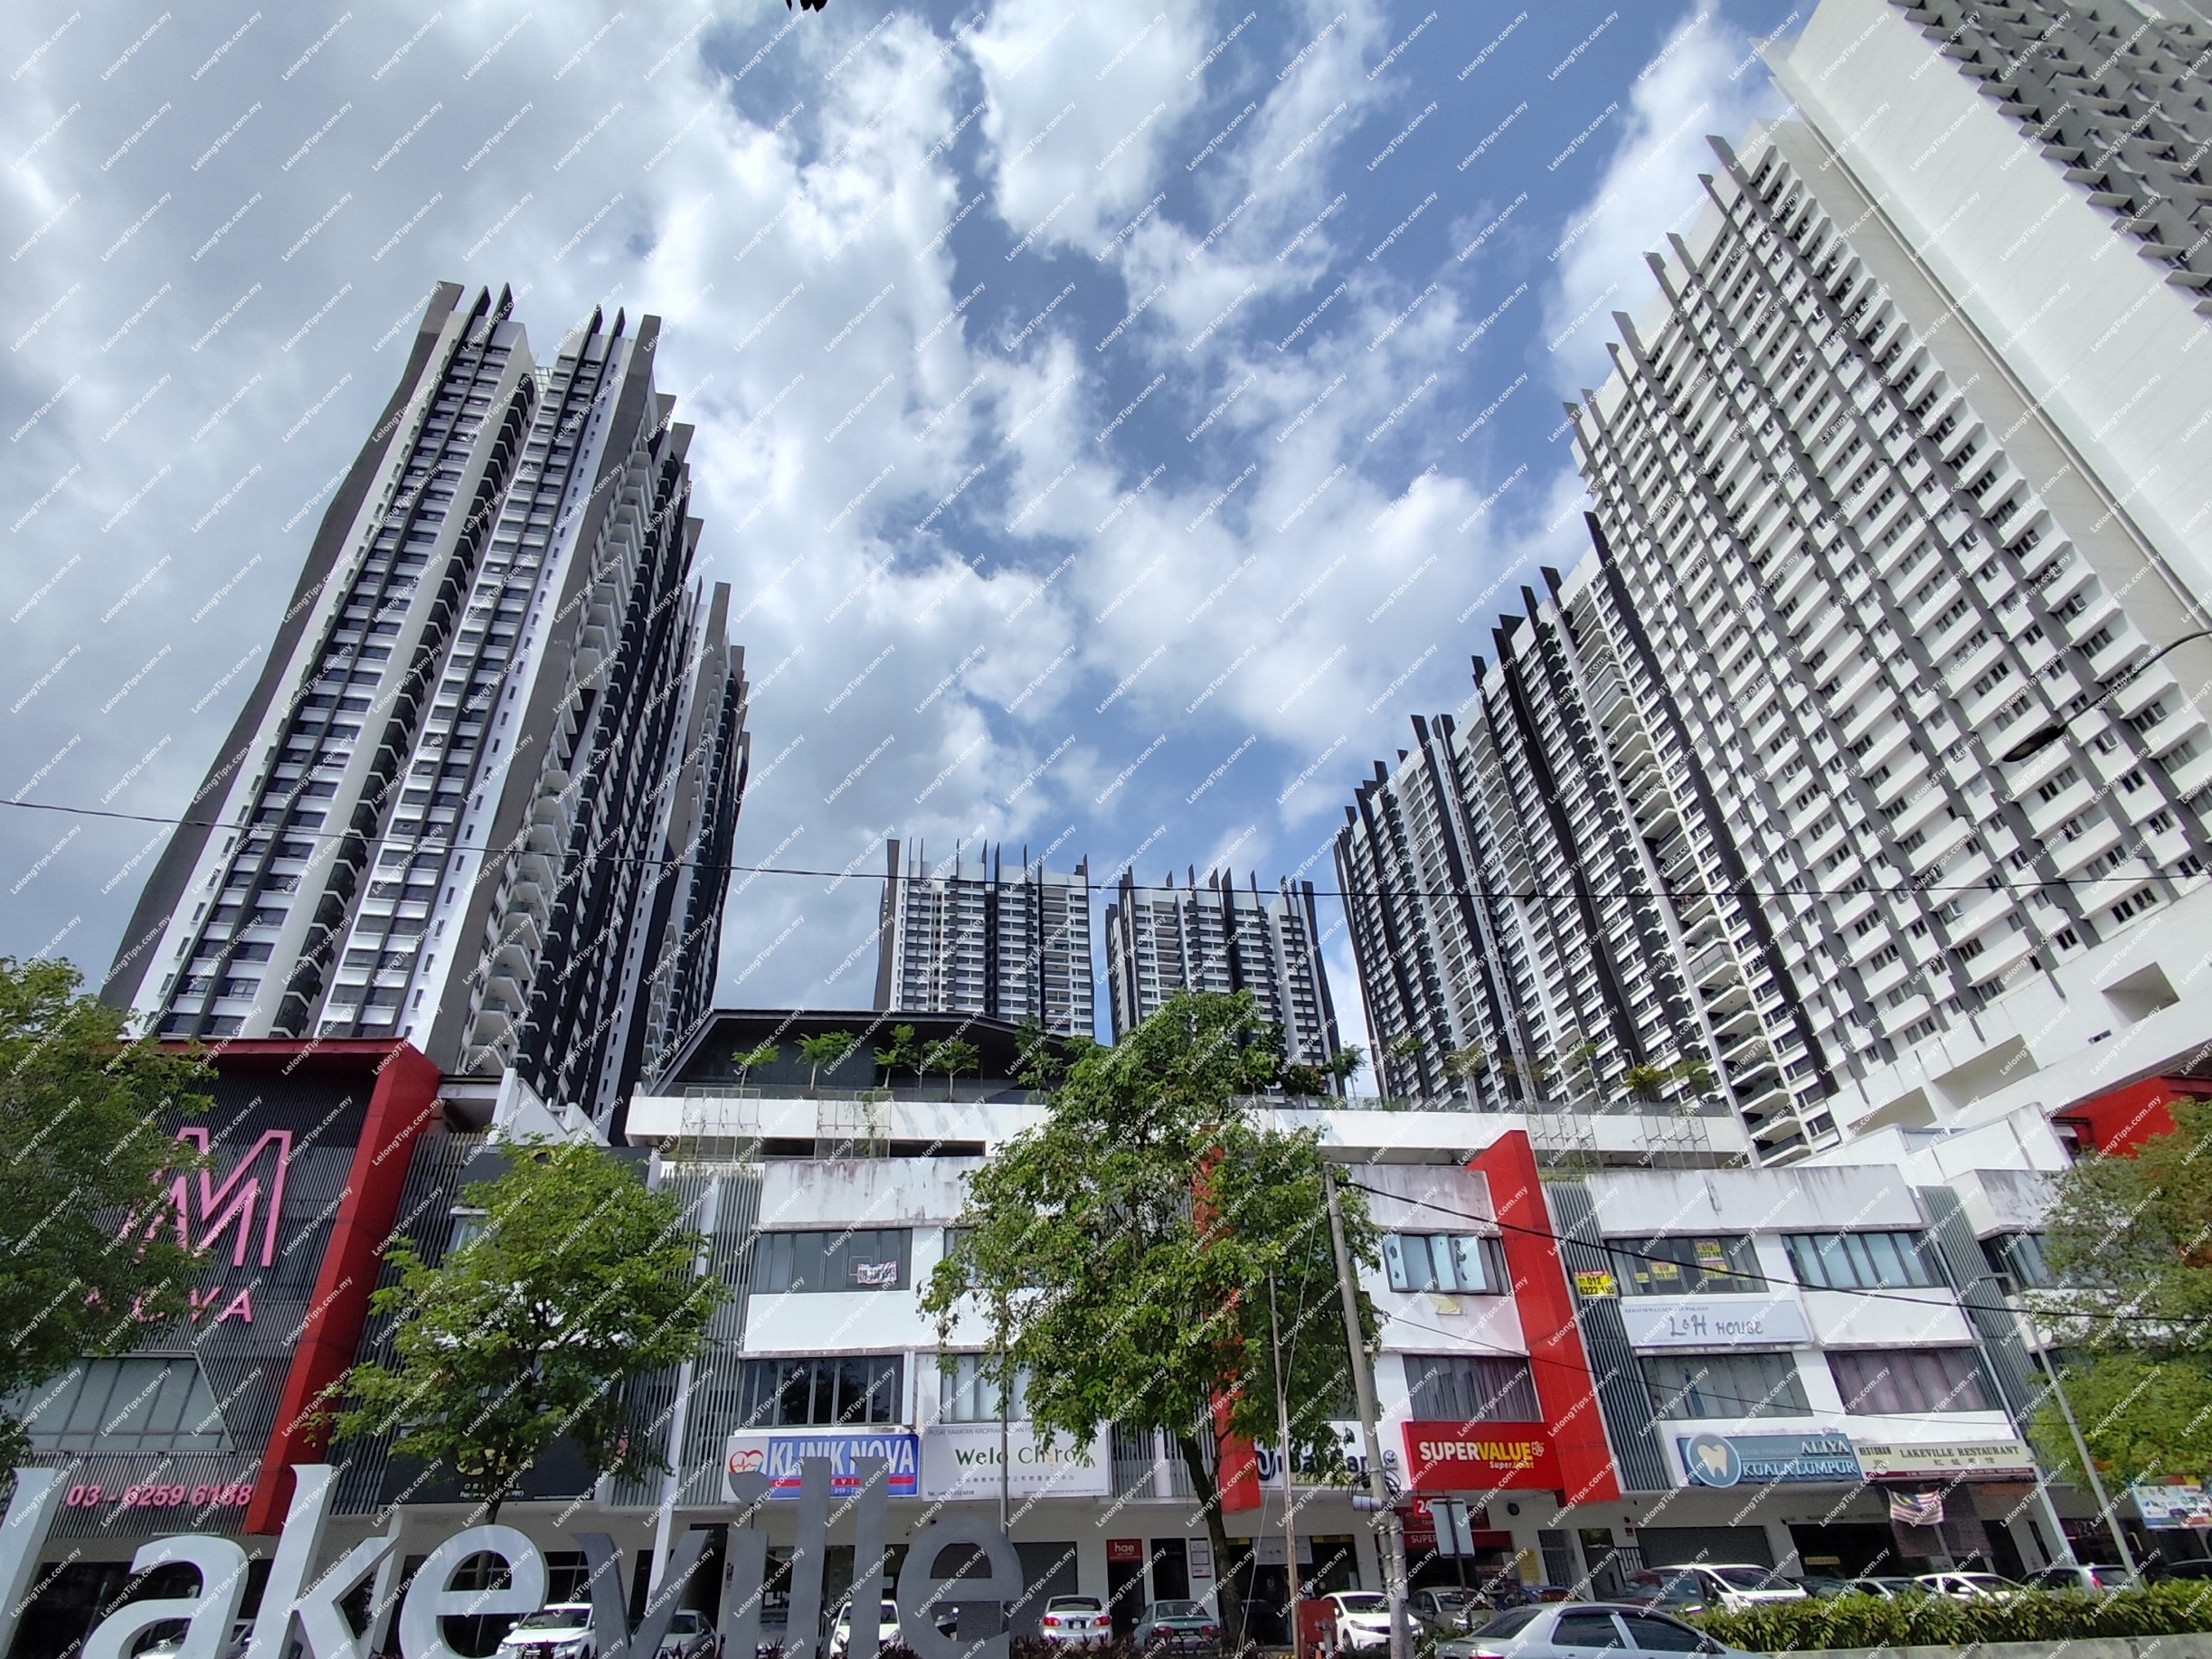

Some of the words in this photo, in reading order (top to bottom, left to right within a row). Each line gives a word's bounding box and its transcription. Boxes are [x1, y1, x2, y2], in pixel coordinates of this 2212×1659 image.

[1587, 1276, 1602, 1286] 012
[1419, 1441, 1534, 1461] SUPERVALUE
[1801, 1439, 1850, 1456] ALIYA
[1900, 1447, 1954, 1458] LAKEVILLE
[1957, 1446, 2019, 1457] RESTAURANT
[1742, 1461, 1793, 1478] KUALA
[1796, 1460, 1858, 1476] LUMPUR
[66, 1485, 102, 1506] 03
[1114, 1542, 1135, 1553] hae
